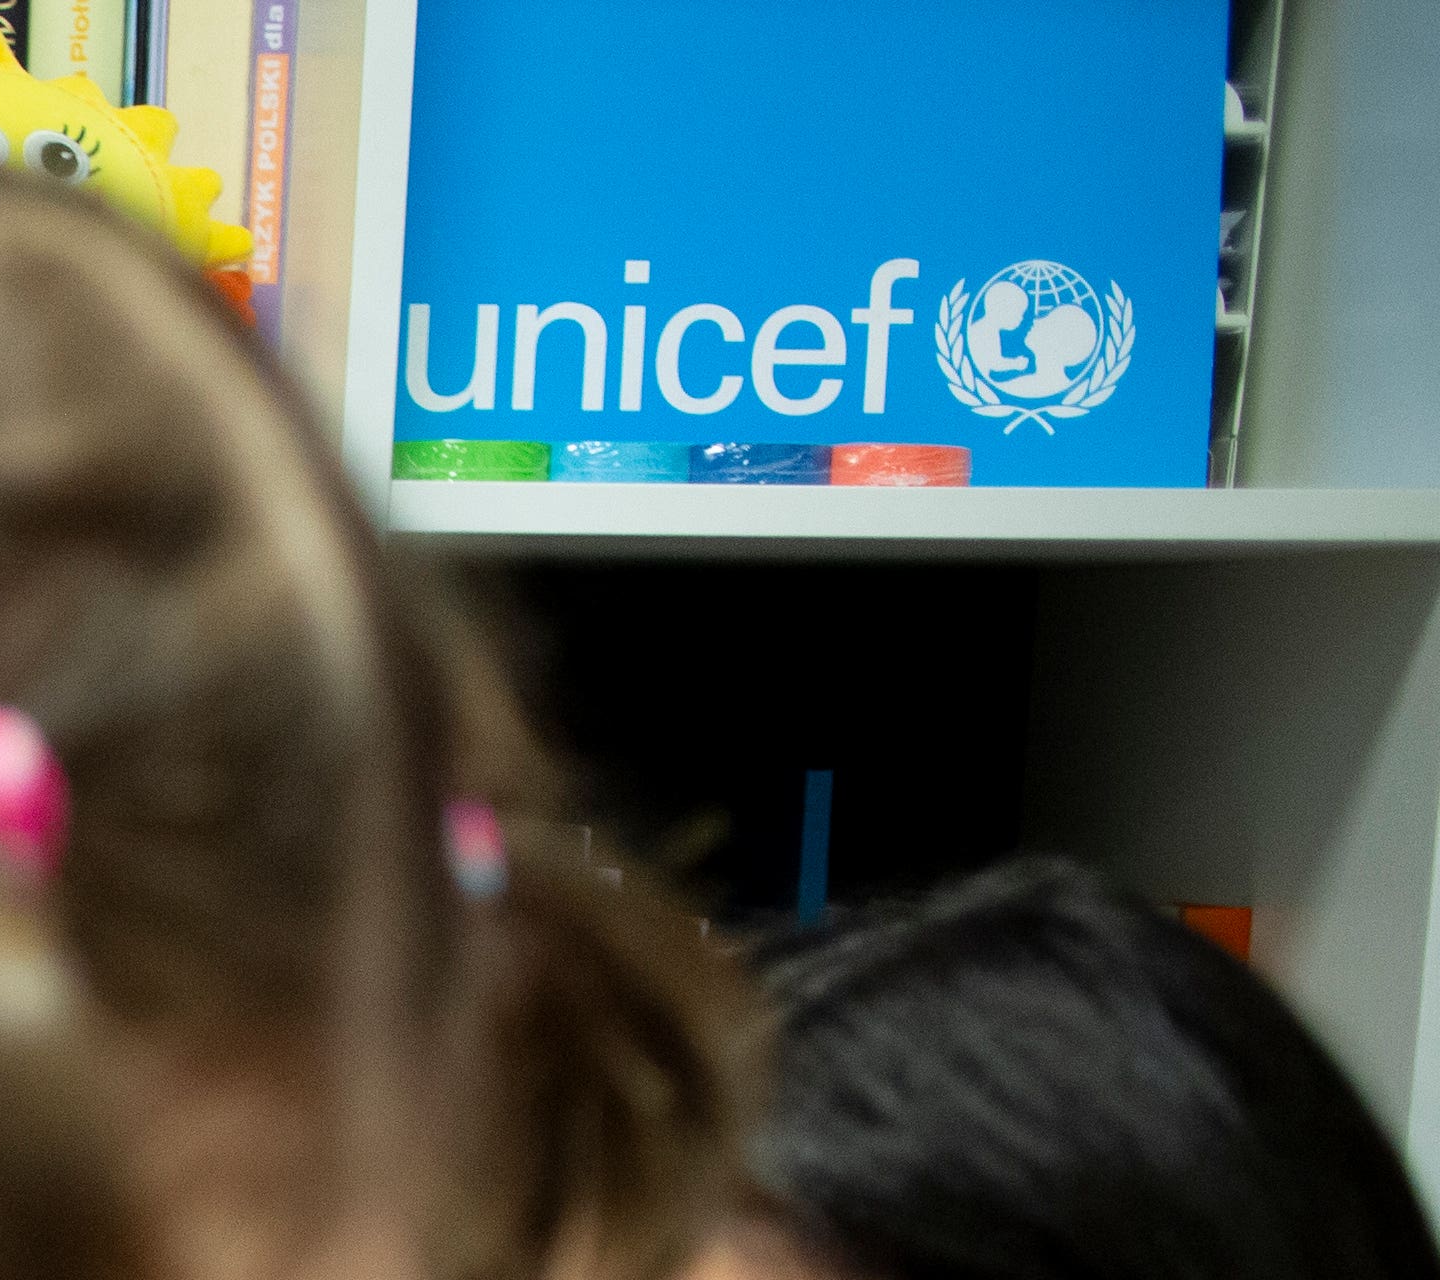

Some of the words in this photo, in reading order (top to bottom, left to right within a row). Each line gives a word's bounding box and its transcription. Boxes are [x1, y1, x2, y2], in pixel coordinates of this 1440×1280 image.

[264, 3, 285, 50] dla
[257, 57, 284, 170] POLSKI
[253, 181, 281, 281] JĘZYK
[405, 258, 920, 416] unicef
